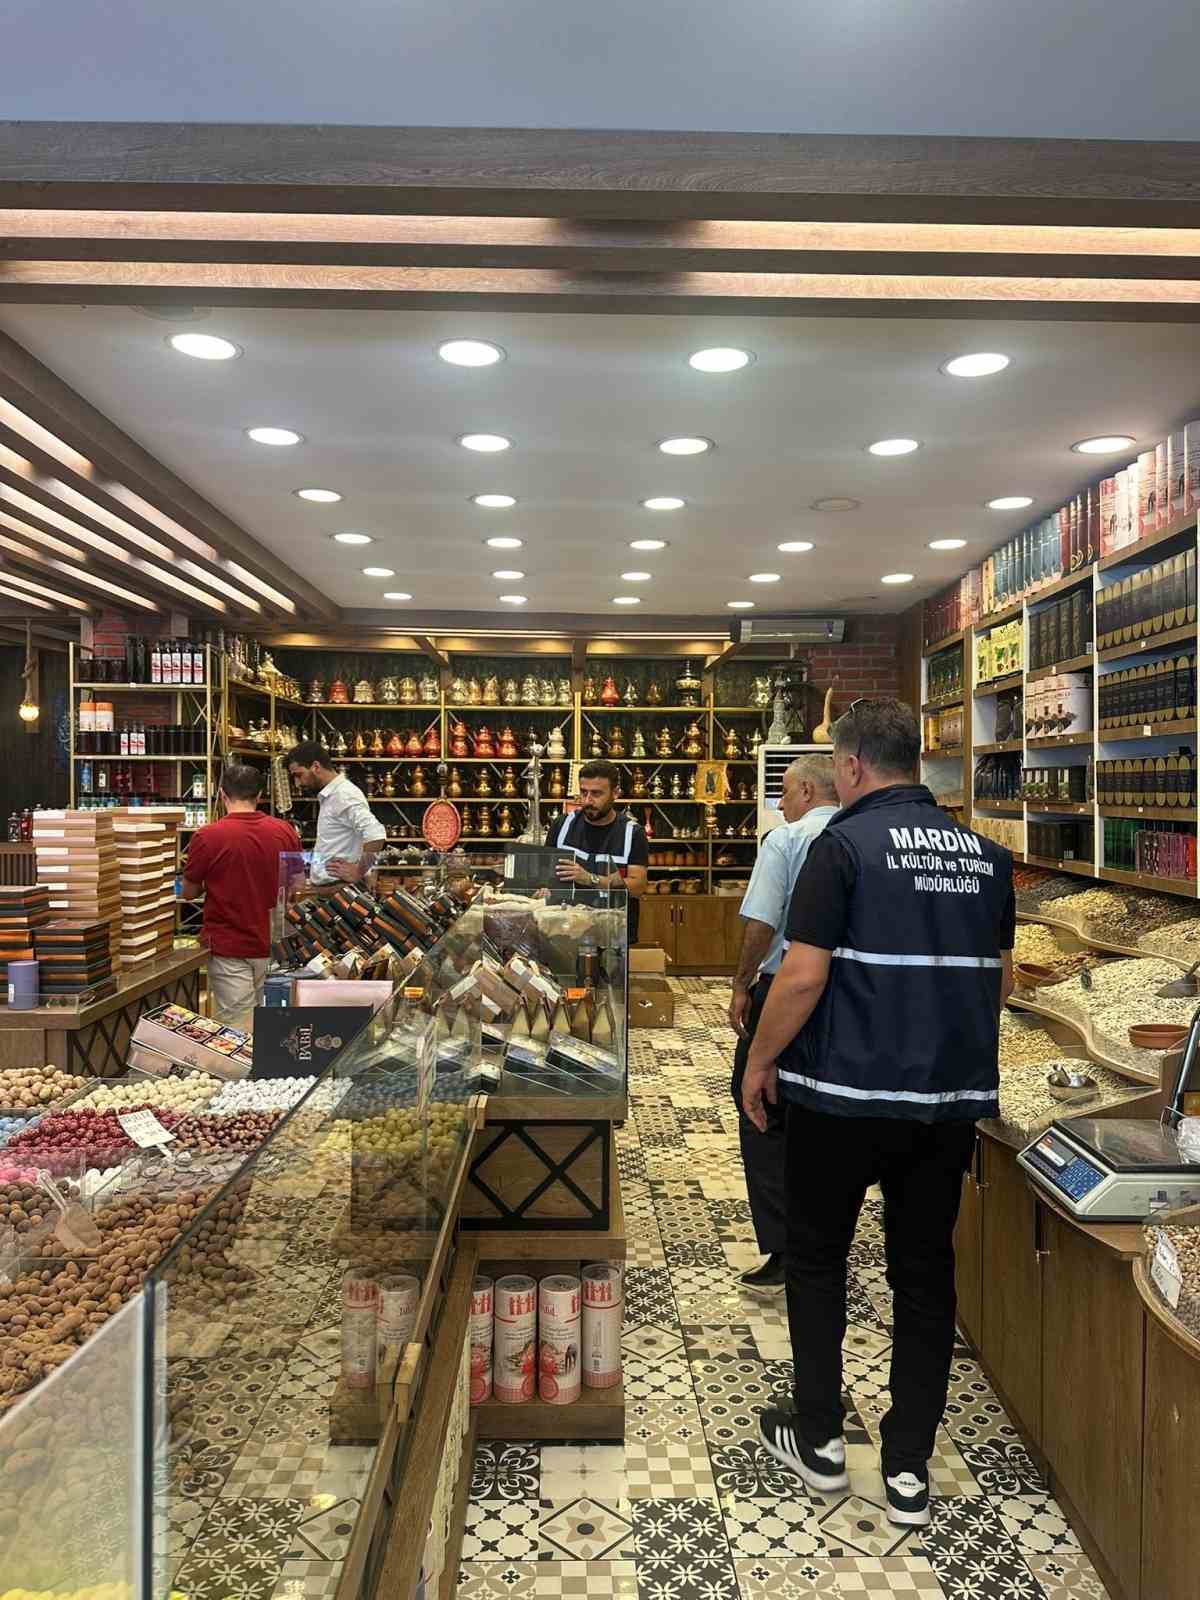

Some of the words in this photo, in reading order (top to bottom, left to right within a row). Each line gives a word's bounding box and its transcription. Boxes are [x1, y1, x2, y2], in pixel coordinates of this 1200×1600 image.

[889, 827, 983, 855] MARDİN
[886, 852, 899, 870] İL
[901, 852, 943, 871] KÜLTÜR
[944, 860, 957, 871] ve
[959, 857, 994, 877] TURİZM
[914, 873, 980, 894] MÜDÜRLÜĞÜ
